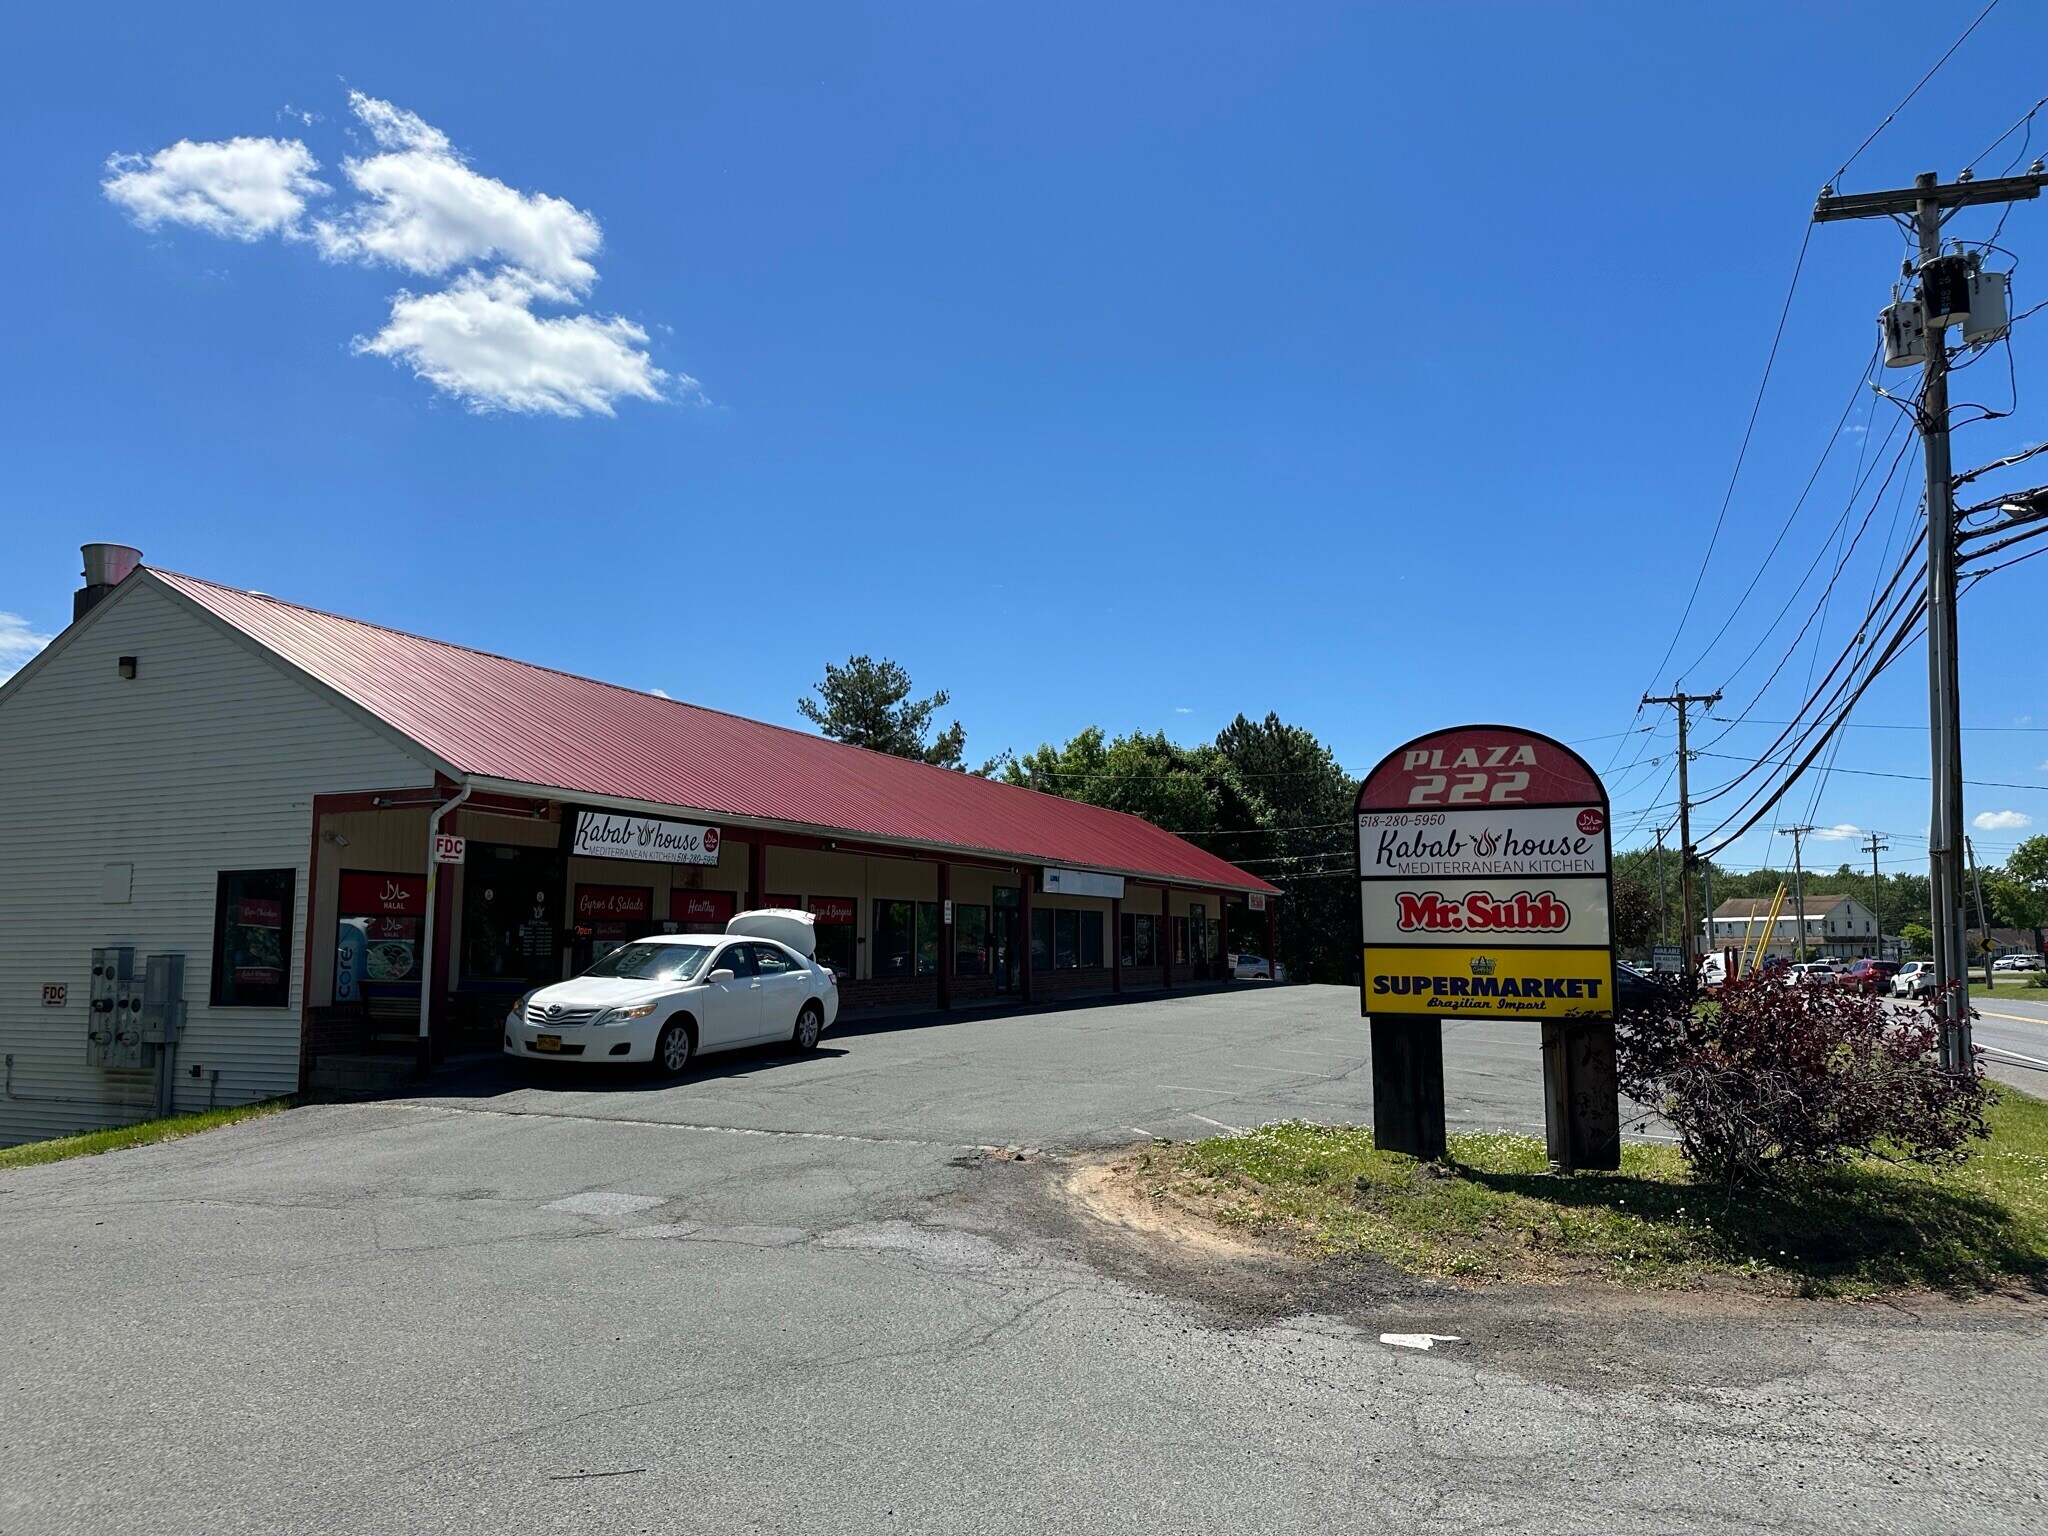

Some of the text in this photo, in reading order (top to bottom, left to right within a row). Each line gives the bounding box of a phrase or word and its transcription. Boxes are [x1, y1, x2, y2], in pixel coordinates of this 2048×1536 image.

[1403, 745, 1537, 771] PLAZA
[1407, 771, 1531, 805] 222
[1360, 813, 1446, 828] 518-280-5950
[574, 812, 700, 852] Kabab house
[436, 838, 463, 855] FDC
[588, 845, 648, 859] MEDITERRANEAN
[649, 851, 677, 862] KITCHEN
[1376, 828, 1594, 868] Kabab house
[1398, 858, 1595, 875] MEDITERRANEAN KITCHEN
[379, 879, 411, 901] حلال
[383, 902, 406, 910] HALAL
[580, 895, 606, 916] Gyros
[616, 895, 644, 912] Salads
[687, 899, 716, 919] Healthy
[1399, 894, 1567, 929] Mr. Subb
[574, 925, 593, 936] Open
[43, 986, 65, 999] FDC
[1373, 975, 1602, 999] SUPERMARKET
[1427, 997, 1547, 1011] Brazilian Import
